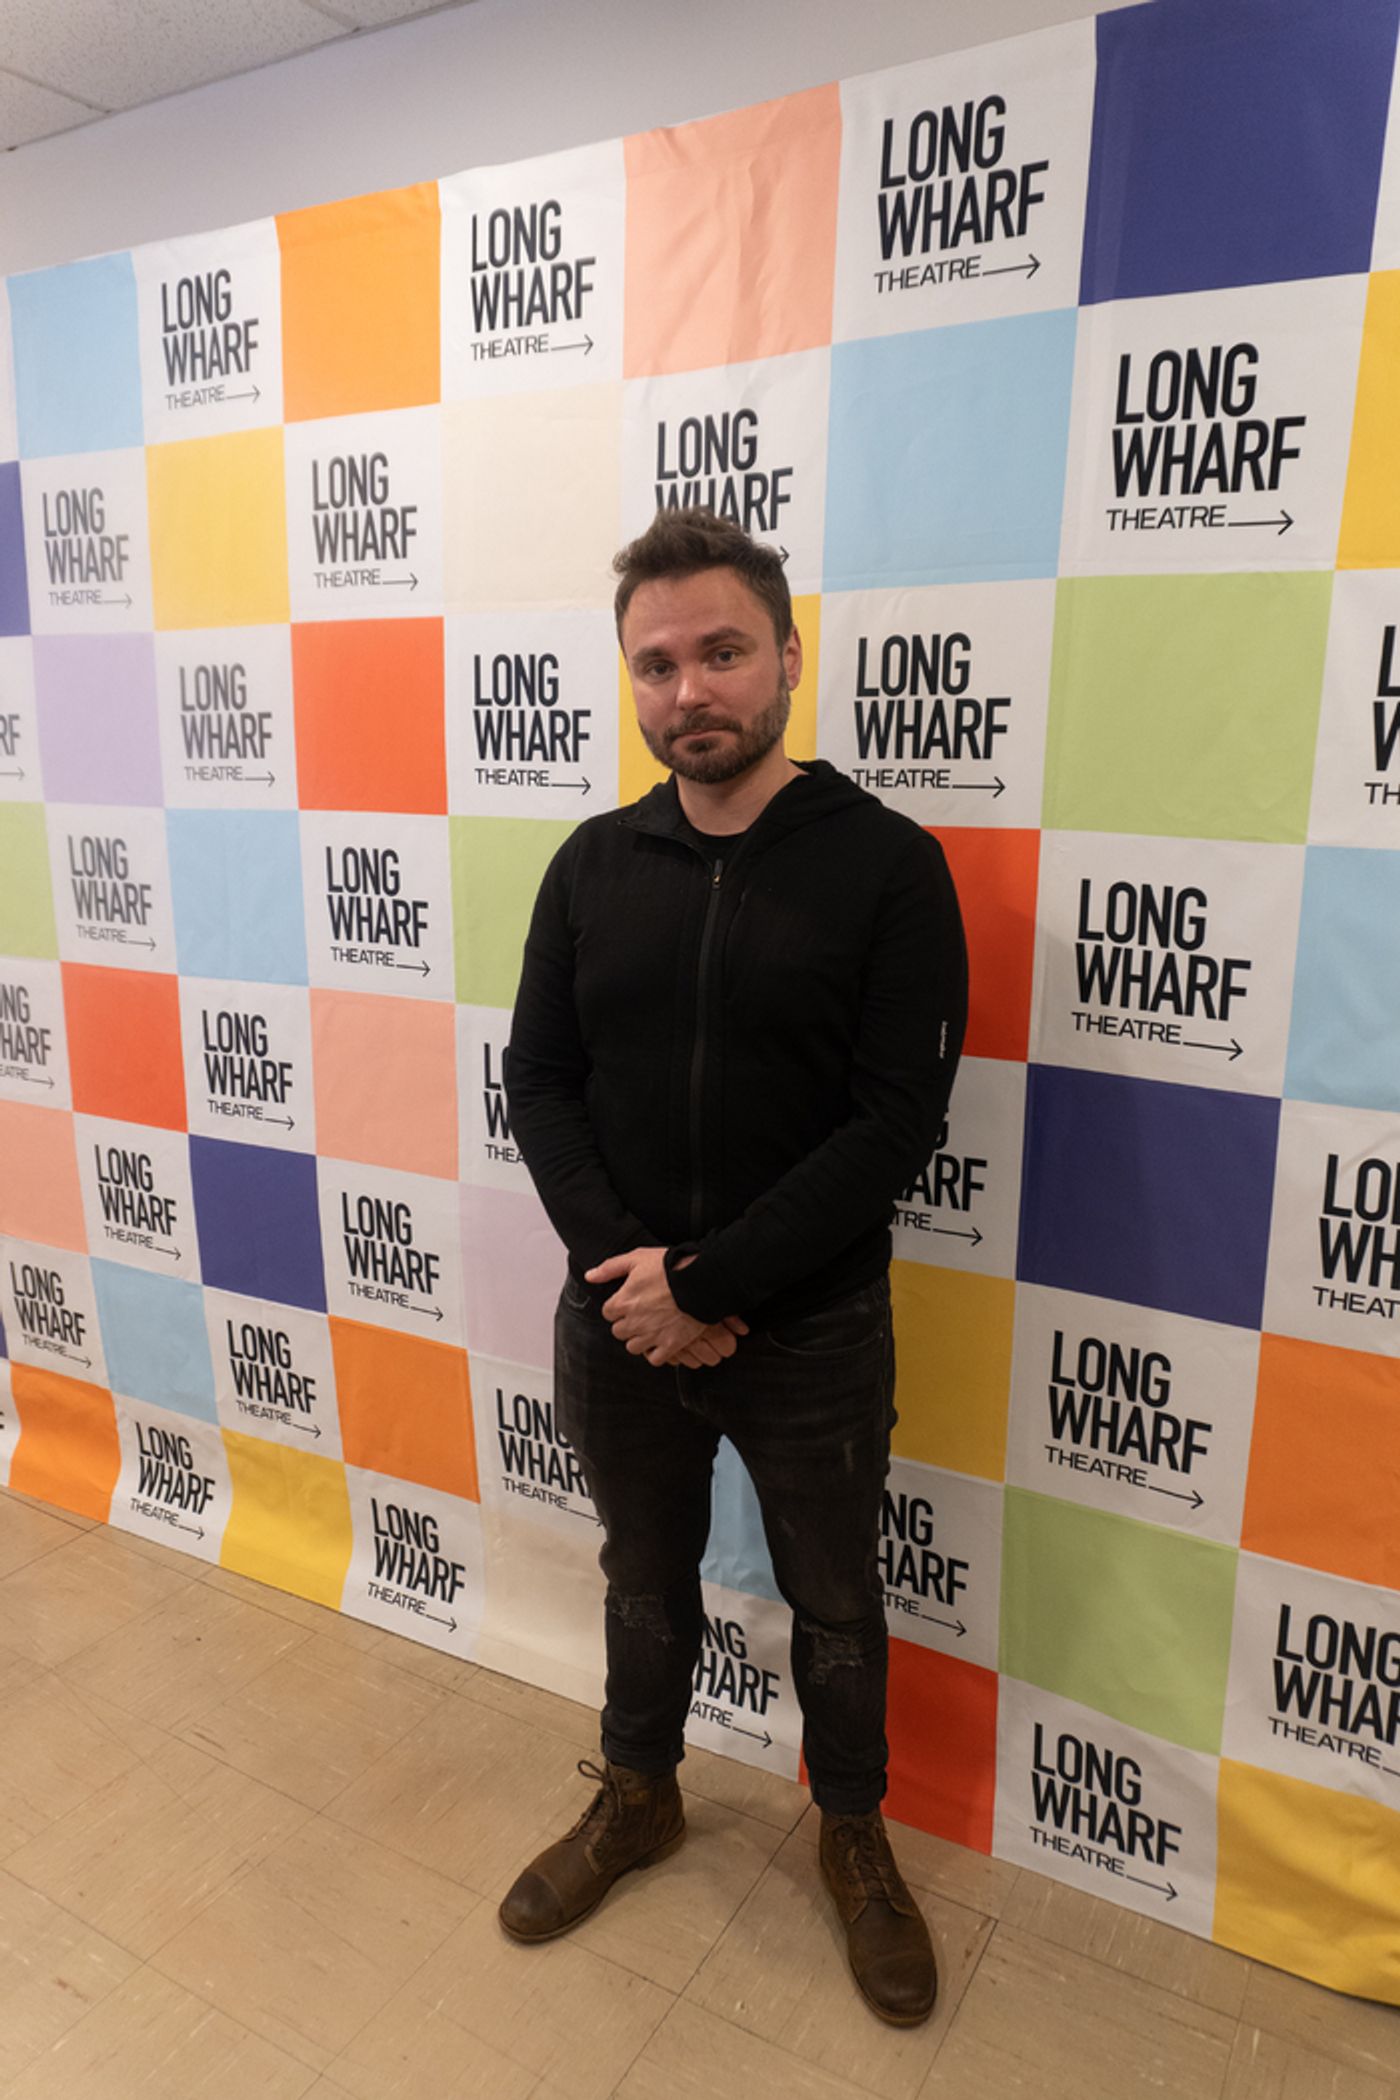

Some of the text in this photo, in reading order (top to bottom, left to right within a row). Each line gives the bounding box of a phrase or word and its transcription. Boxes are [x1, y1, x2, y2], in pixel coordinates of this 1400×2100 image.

[881, 95, 1006, 189] LONG
[878, 160, 1049, 260] WHARF
[472, 201, 561, 272] LONG
[471, 258, 595, 333] WHARF
[875, 256, 981, 293] THEATRE
[162, 270, 231, 333] LONG
[163, 319, 258, 386] WHARF
[471, 335, 549, 361] THEATRE
[165, 384, 226, 410] THEATRE
[1116, 343, 1258, 425] LONG
[657, 409, 757, 480] LONG
[1112, 416, 1306, 498] WHARF
[312, 452, 388, 511] LONG
[43, 488, 104, 537] LONG
[313, 507, 416, 563] WHARF
[1107, 505, 1226, 531] THEATRE
[45, 534, 128, 584] WHARF
[314, 568, 381, 589] THEATRE
[48, 590, 102, 605] THEATRE
[179, 664, 246, 711] LONG
[474, 654, 558, 707] LONG
[857, 633, 971, 697] LONG
[181, 712, 272, 759] WHARF
[474, 709, 591, 762] WHARF
[854, 698, 1011, 760] WHARF
[184, 766, 243, 781] THEATRE
[474, 768, 549, 787] THEATRE
[853, 768, 951, 788] THEATRE
[68, 836, 128, 880] LONG
[326, 847, 400, 896] LONG
[72, 878, 152, 926] WHARF
[327, 895, 428, 947] WHARF
[1078, 879, 1207, 951] LONG
[76, 926, 128, 942] THEATRE
[330, 946, 394, 967] THEATRE
[0, 985, 30, 1024] NG
[1075, 943, 1251, 1021] WHARF
[0, 1023, 51, 1065] HARF
[202, 1010, 268, 1057] LONG
[1072, 1012, 1181, 1045] THEATRE
[204, 1053, 292, 1103] WHARF
[207, 1100, 263, 1121] THEATRE
[95, 1145, 153, 1192] LONG
[485, 1143, 523, 1164] THEA
[890, 1153, 987, 1212] ARF
[1323, 1154, 1400, 1226] LO
[99, 1184, 176, 1236] WHARF
[342, 1192, 412, 1246] LONG
[104, 1225, 153, 1249] THEATRE
[10, 1262, 64, 1306] LONG
[344, 1235, 439, 1294] WHARF
[348, 1281, 408, 1308] THEATRE
[1313, 1286, 1400, 1318] THEAT
[15, 1297, 85, 1346] WHARF
[22, 1333, 68, 1356] THEATRE
[227, 1320, 291, 1369] LONG
[230, 1359, 316, 1413] WHARF
[1052, 1330, 1171, 1408] LONG
[236, 1400, 291, 1426] THEATRE
[1049, 1385, 1212, 1474] WHARF
[136, 1422, 193, 1470] LONG
[498, 1431, 592, 1497] WHAR
[1045, 1445, 1147, 1487] THEATRE
[138, 1456, 215, 1514] WHARF
[503, 1476, 568, 1508] THEATRE
[130, 1497, 180, 1527] THEATRE
[371, 1498, 439, 1553] LONG
[882, 1490, 933, 1547] NG
[374, 1536, 465, 1603] WHARF
[877, 1539, 969, 1606] HARF
[368, 1582, 426, 1616] THEATRE
[702, 1614, 747, 1659] NG
[694, 1648, 780, 1715] HARF
[1273, 1659, 1400, 1746] WHA
[690, 1700, 733, 1728] ATRE
[1034, 1723, 1141, 1806] LONG
[1269, 1717, 1381, 1768] THEATRE
[1031, 1771, 1181, 1866] WHARF
[1030, 1826, 1124, 1876] THEATRE
